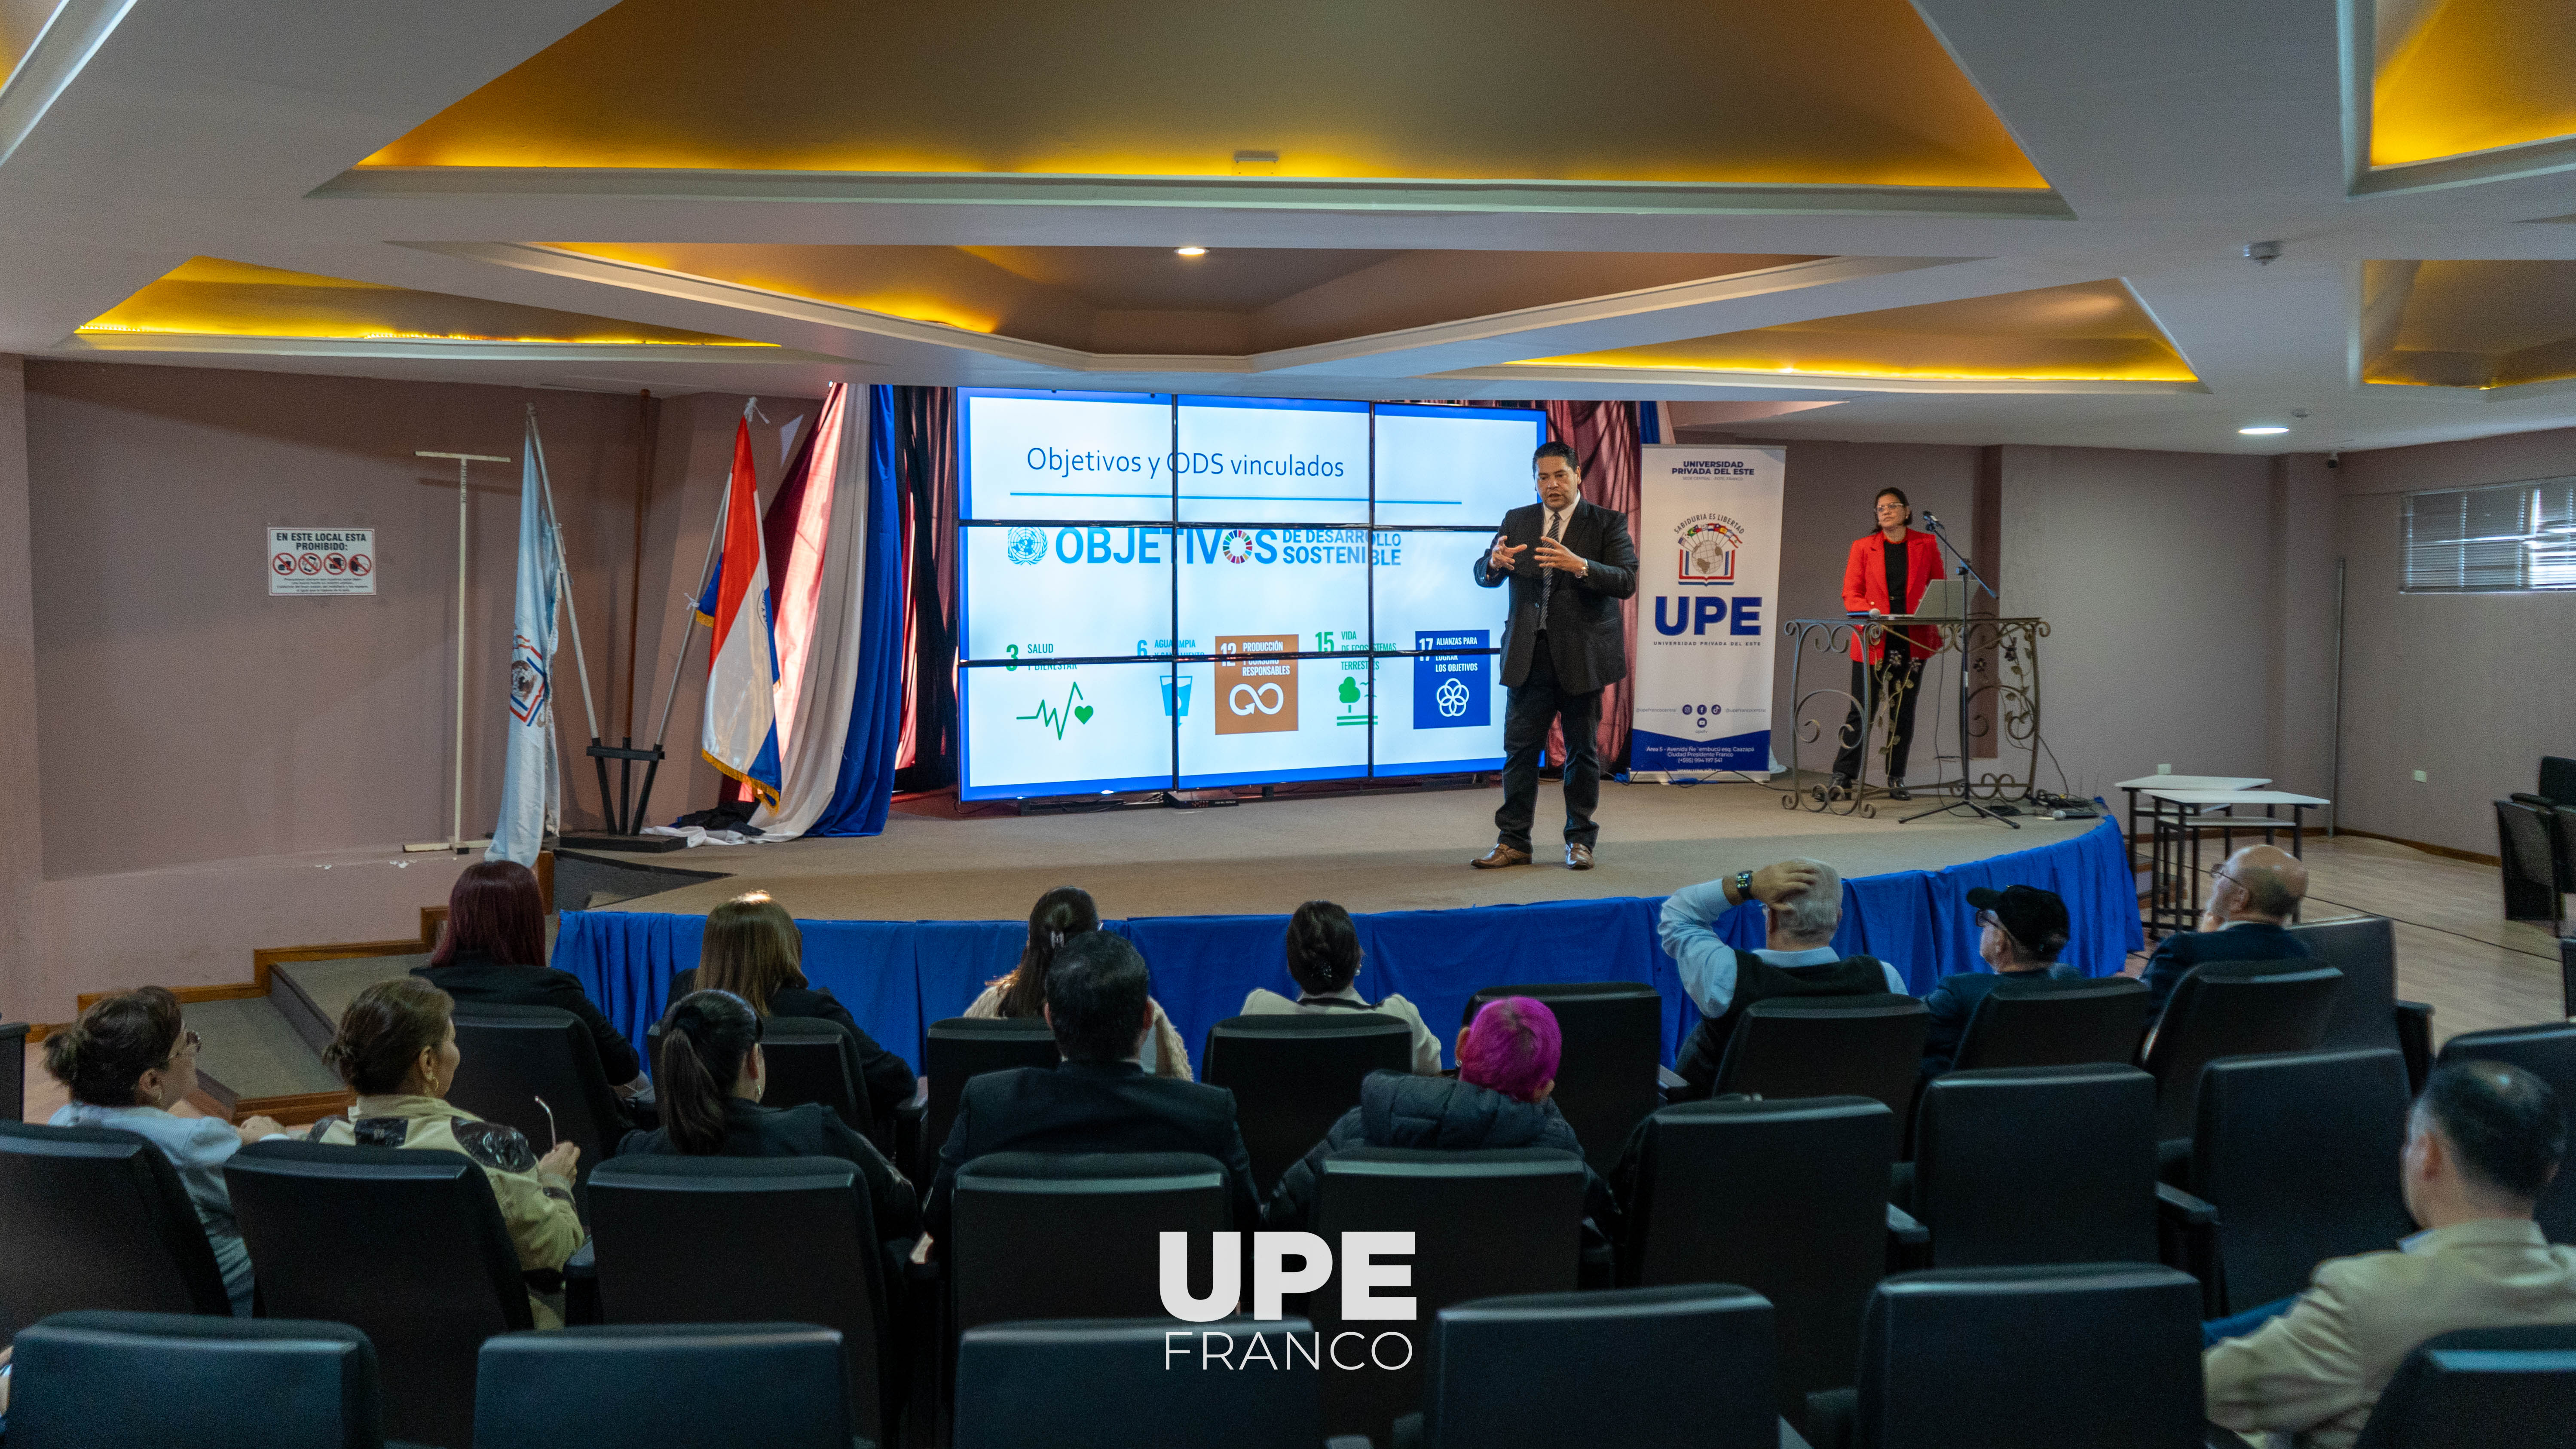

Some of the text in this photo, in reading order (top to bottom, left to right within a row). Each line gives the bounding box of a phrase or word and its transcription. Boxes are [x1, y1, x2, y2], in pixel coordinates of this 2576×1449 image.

[1027, 447, 1344, 479] Objetivos y ODS vinculados
[1674, 514, 1707, 534] SABIDURIA
[1717, 514, 1744, 534] LIBERTAD
[276, 532, 367, 542] EN ESTE LOCAL ESTA
[1055, 527, 1278, 564] OBJETIVOS
[1283, 529, 1401, 547] DE DESARROLLO
[296, 542, 348, 551] PROHIBIDO:
[1283, 546, 1401, 566] SOSTENIBLE
[1655, 596, 1762, 636] UPE
[1154, 639, 1196, 648] AGUA MPIA
[1315, 631, 1334, 652] 15
[1341, 631, 1357, 640] VIDA
[1028, 643, 1053, 654] SALUD
[1137, 639, 1147, 656] 6
[1221, 642, 1237, 666] 12
[1243, 640, 1283, 651] PRODUCCIÓN
[1352, 643, 1396, 651] ECOSSTEMAS
[1419, 638, 1433, 661] 17
[1006, 644, 1019, 671] 3
[1341, 661, 1380, 670] TERRESTES
[1242, 666, 1290, 676] RESPONSABLES
[1435, 663, 1478, 673] LOS OBJETIVOS
